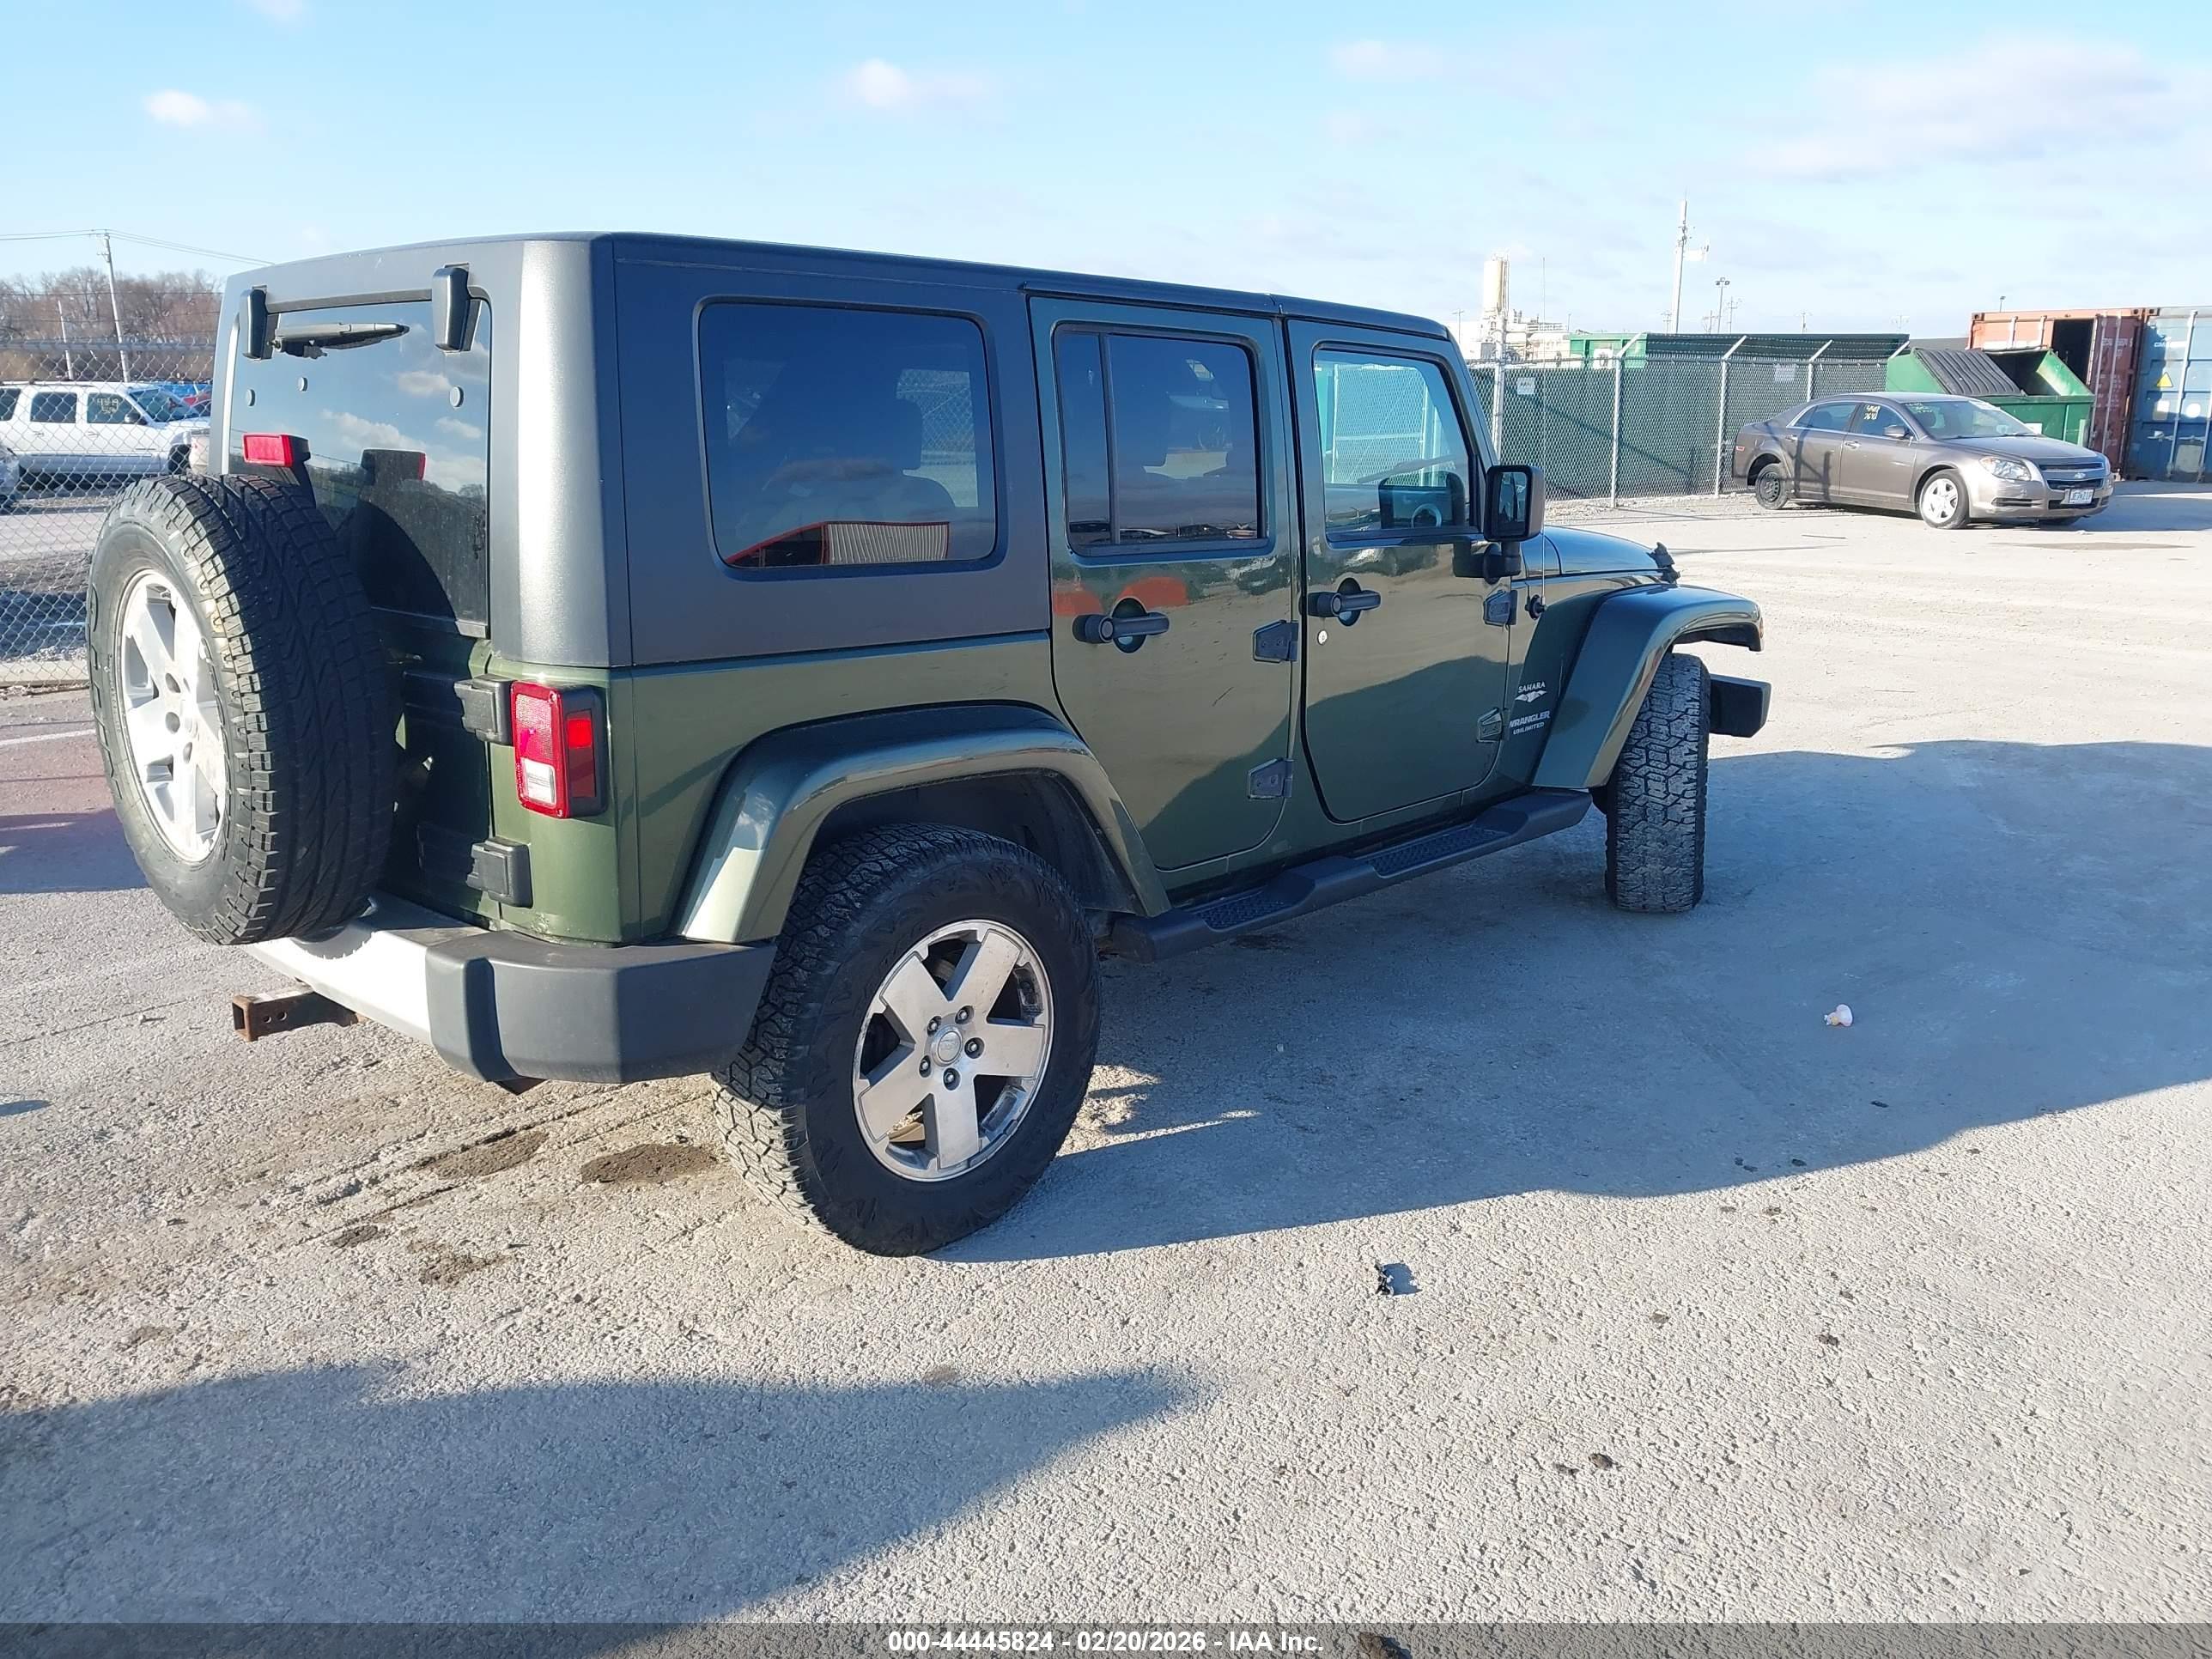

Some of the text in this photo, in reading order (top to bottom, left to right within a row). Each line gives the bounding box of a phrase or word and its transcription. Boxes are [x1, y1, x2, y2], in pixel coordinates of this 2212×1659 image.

[1518, 681, 1546, 693] SAHARA
[1509, 710, 1551, 728] WRANGLER
[1513, 722, 1545, 735] UNLIMITED
